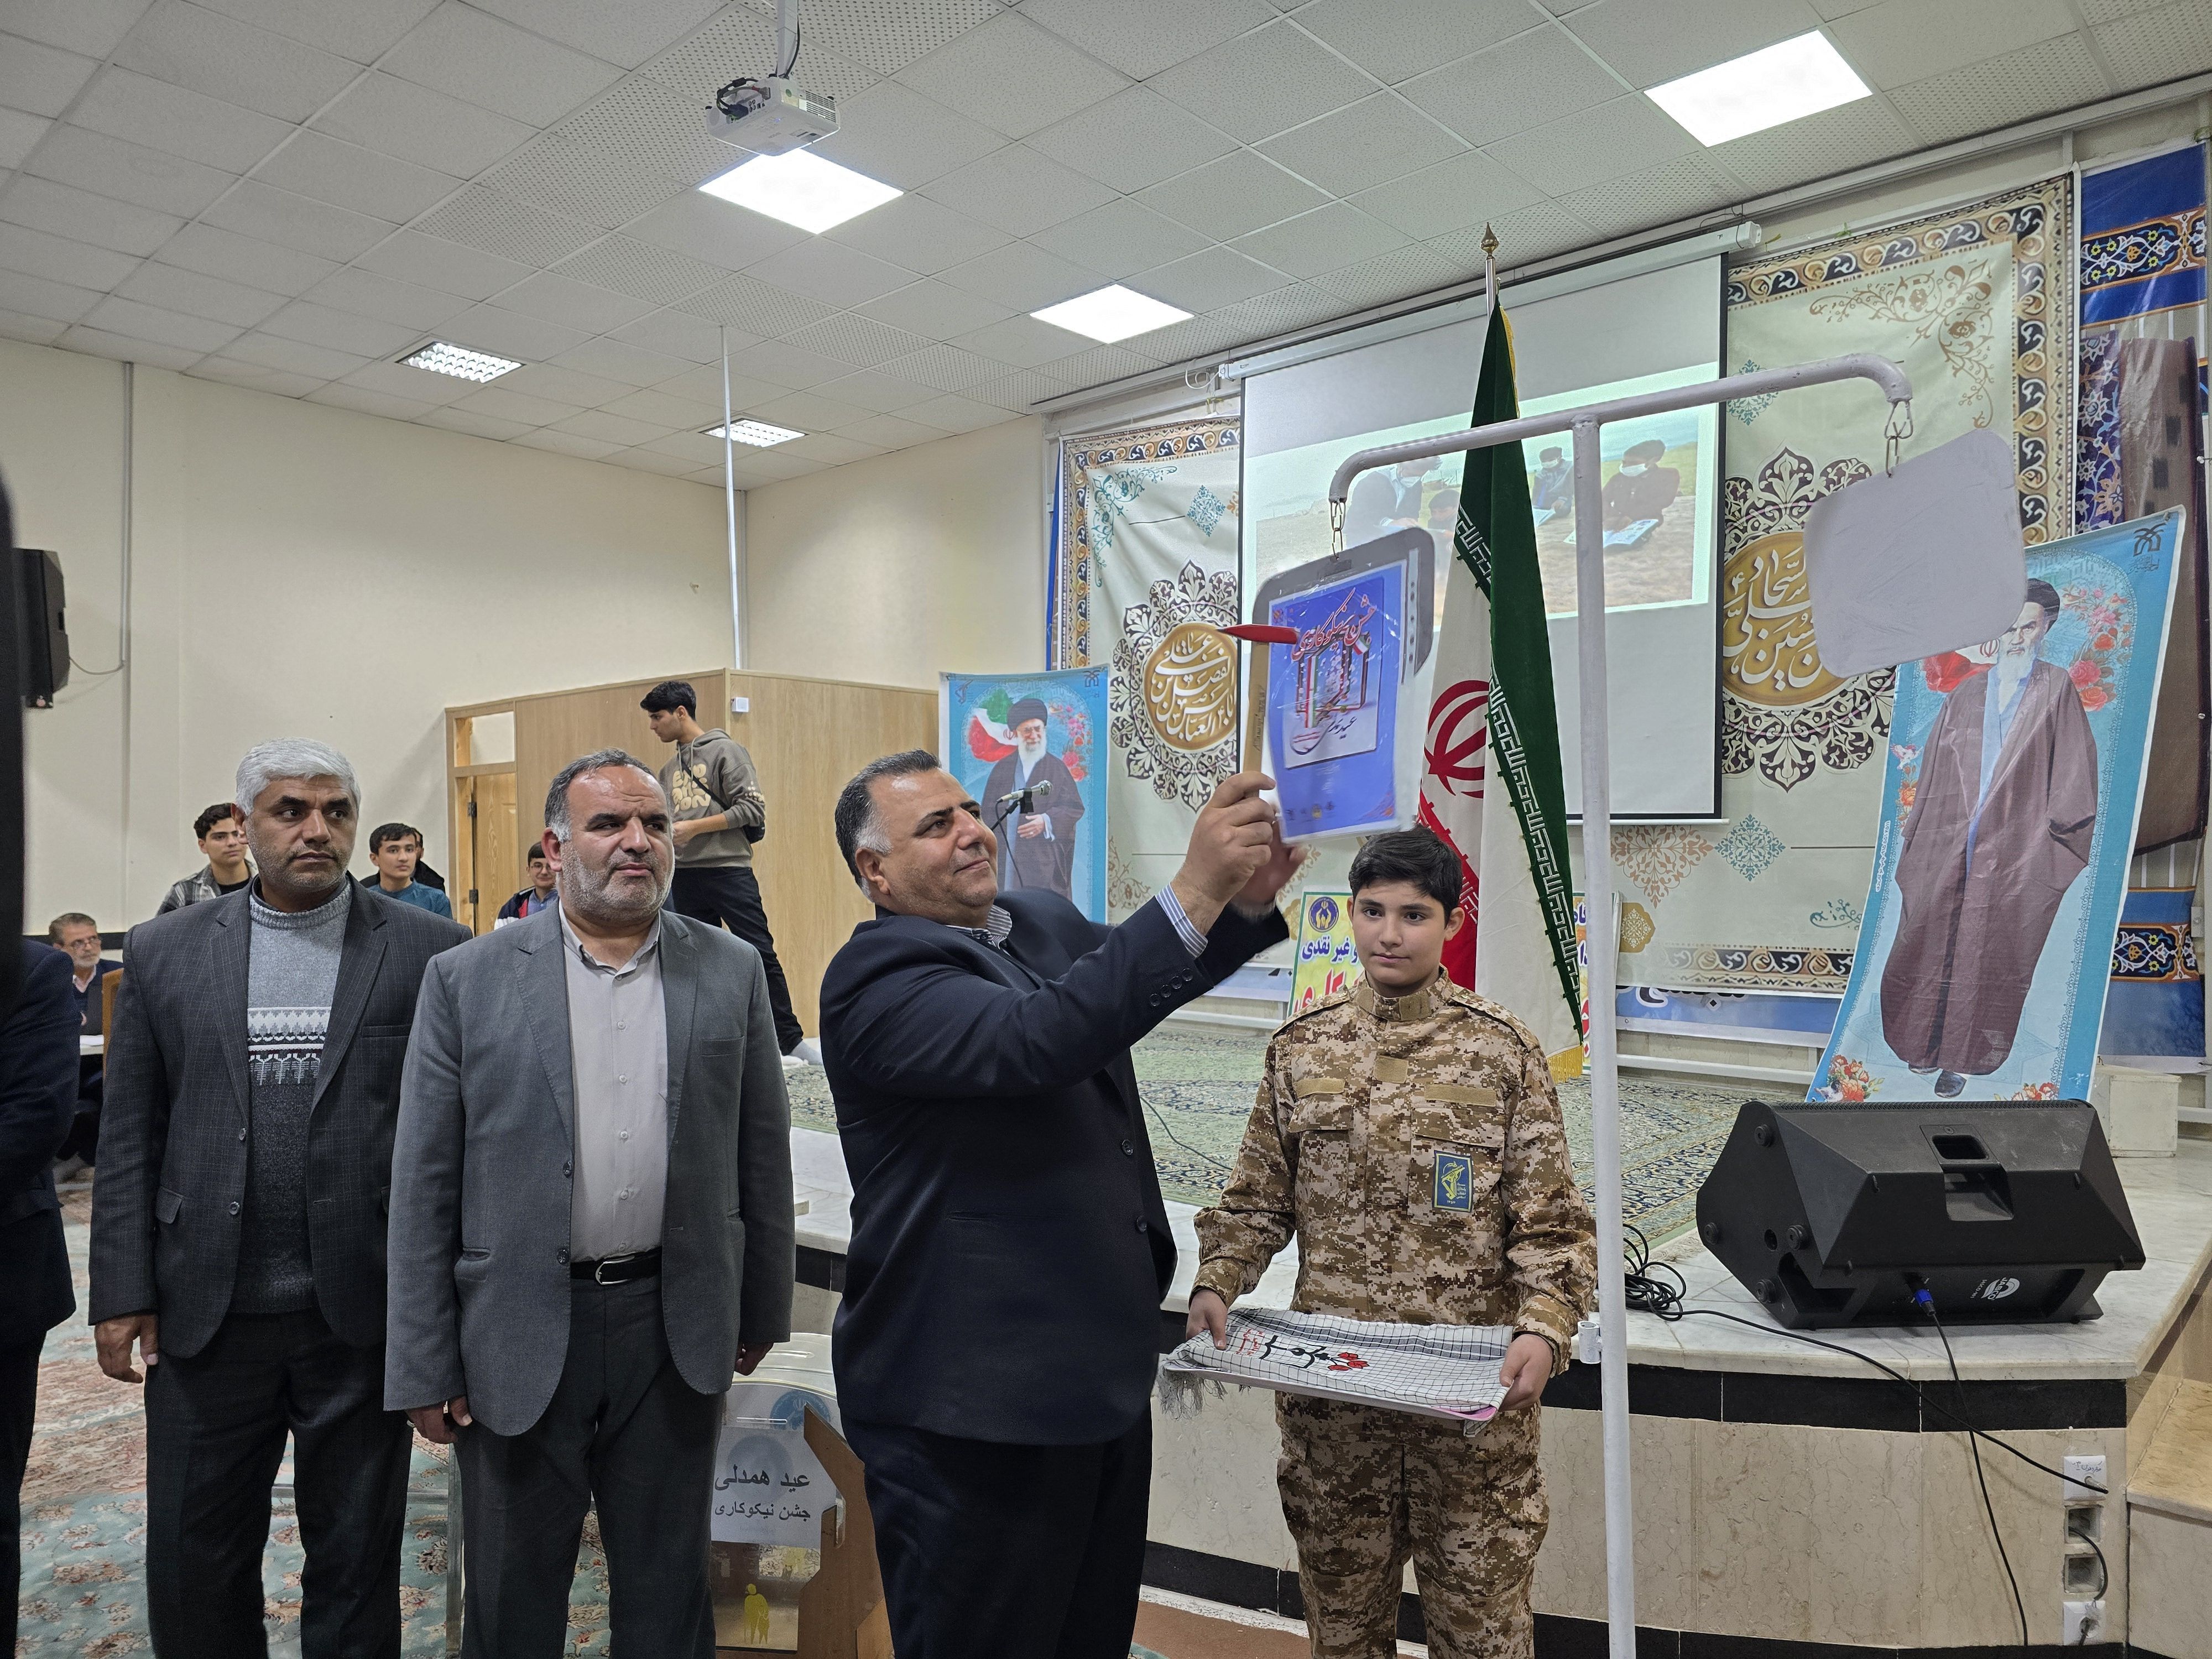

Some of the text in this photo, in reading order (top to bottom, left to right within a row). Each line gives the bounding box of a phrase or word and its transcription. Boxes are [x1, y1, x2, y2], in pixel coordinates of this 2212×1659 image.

[1302, 936, 1331, 959] نقدی
[1332, 938, 1350, 962] غیر
[714, 1464, 810, 1493] عید همدلی
[714, 1501, 811, 1522] جشن نیکوکاری
